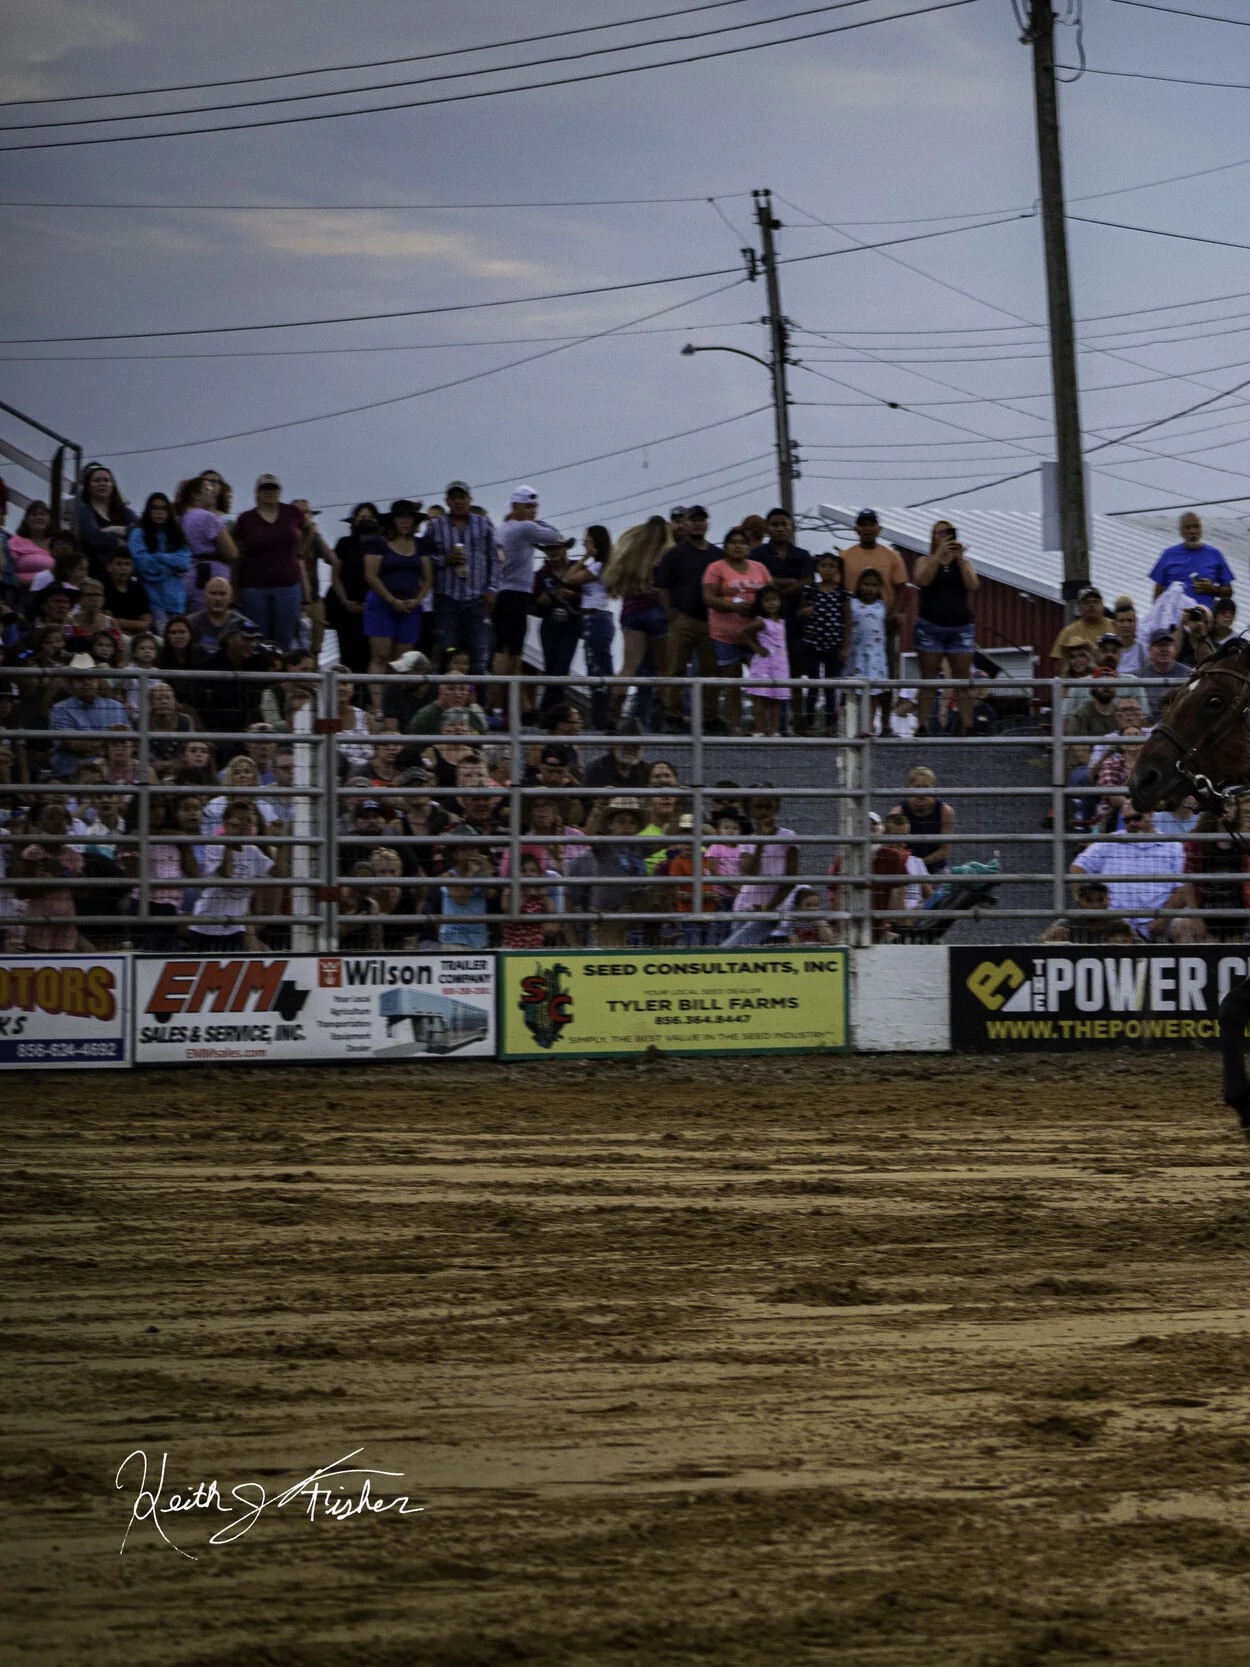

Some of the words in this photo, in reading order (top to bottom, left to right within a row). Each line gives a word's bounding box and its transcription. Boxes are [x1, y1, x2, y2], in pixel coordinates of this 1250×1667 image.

[345, 960, 434, 986] Wilson
[440, 960, 489, 971] TRAILER
[583, 964, 638, 976] SEED
[642, 961, 799, 976] CONSULTANTS,
[804, 961, 839, 973] INC
[145, 960, 289, 1014] EMM
[439, 974, 491, 985] COMPANY
[1032, 958, 1046, 1012] THE
[1046, 957, 1208, 1012] POWER
[607, 999, 672, 1012] TYLER
[678, 999, 724, 1011] BILL
[729, 997, 800, 1010] FARMS
[140, 1026, 190, 1044] SALES
[190, 1026, 201, 1043] &
[203, 1025, 273, 1045] SERVICE,
